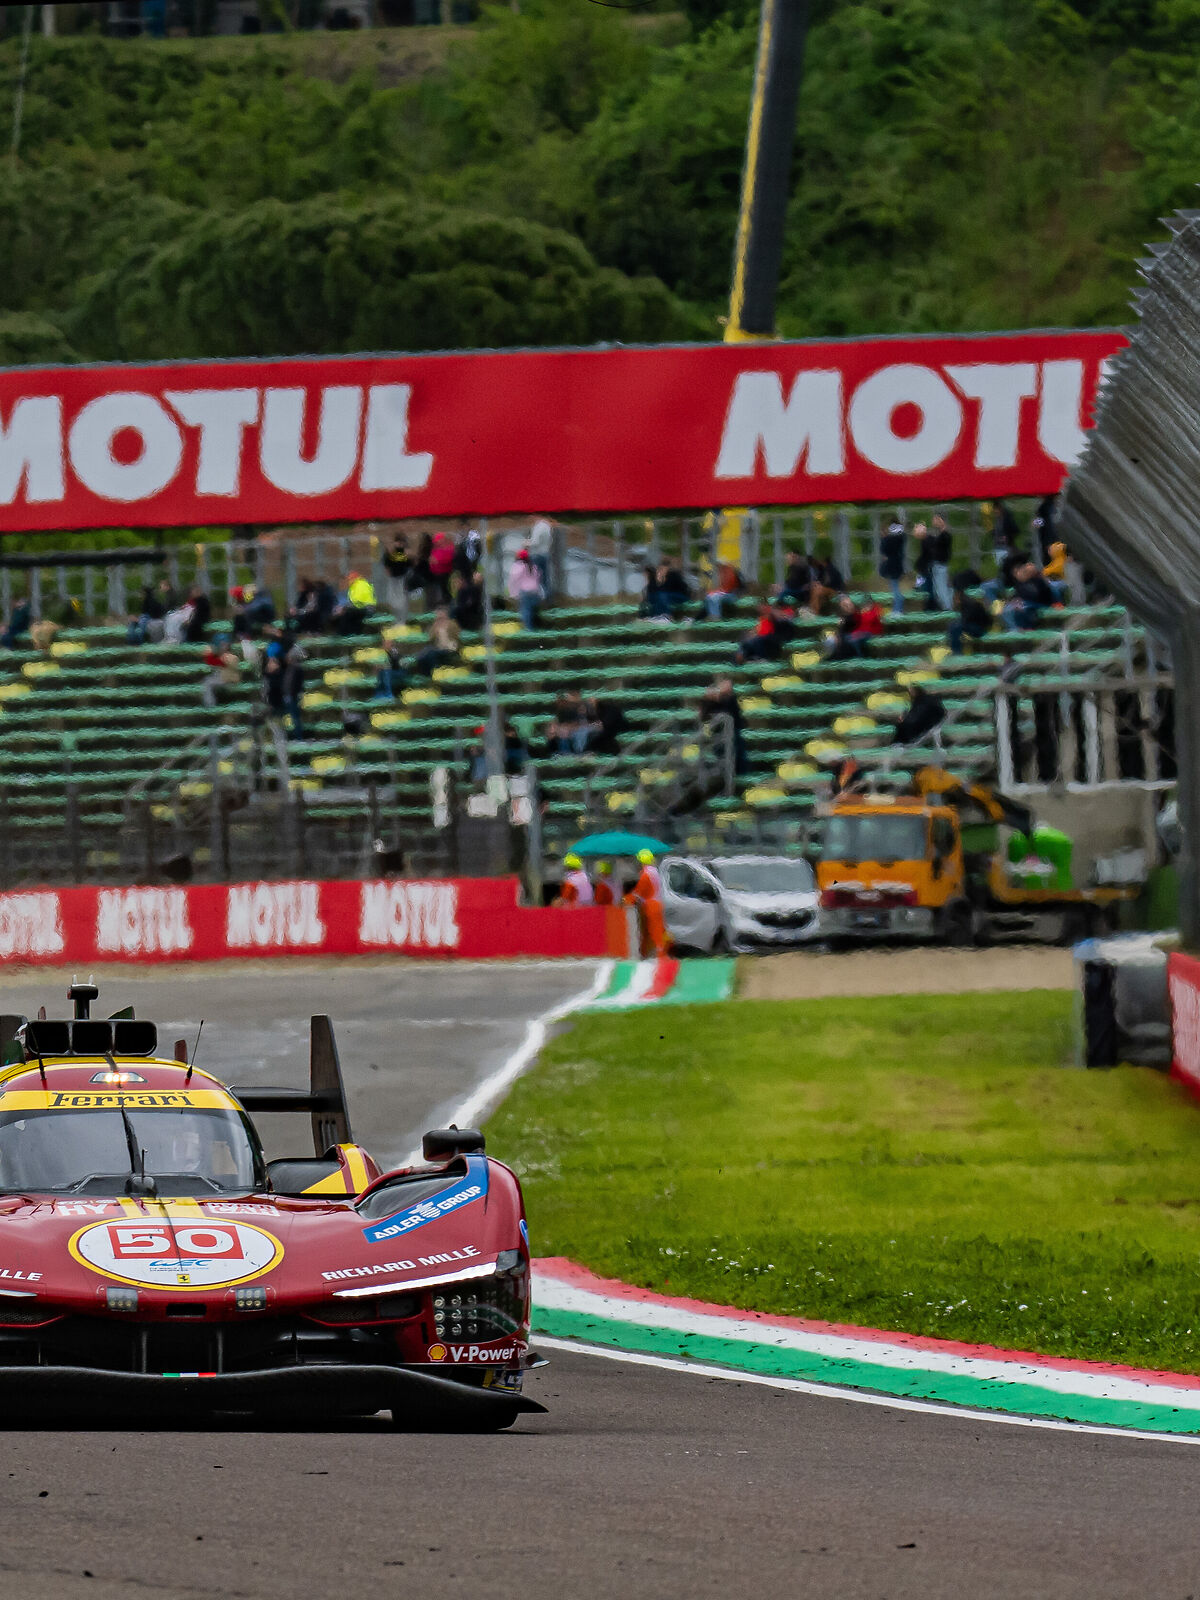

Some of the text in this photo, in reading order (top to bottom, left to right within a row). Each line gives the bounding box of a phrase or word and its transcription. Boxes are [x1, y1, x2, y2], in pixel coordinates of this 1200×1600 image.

[715, 359, 1112, 479] MOTU
[49, 1091, 195, 1107] Ferrari
[373, 1185, 482, 1239] ADLER GROUP
[116, 1228, 234, 1254] 50
[320, 1245, 482, 1281] RICHARD MILLE
[450, 1345, 515, 1362] V-Power
